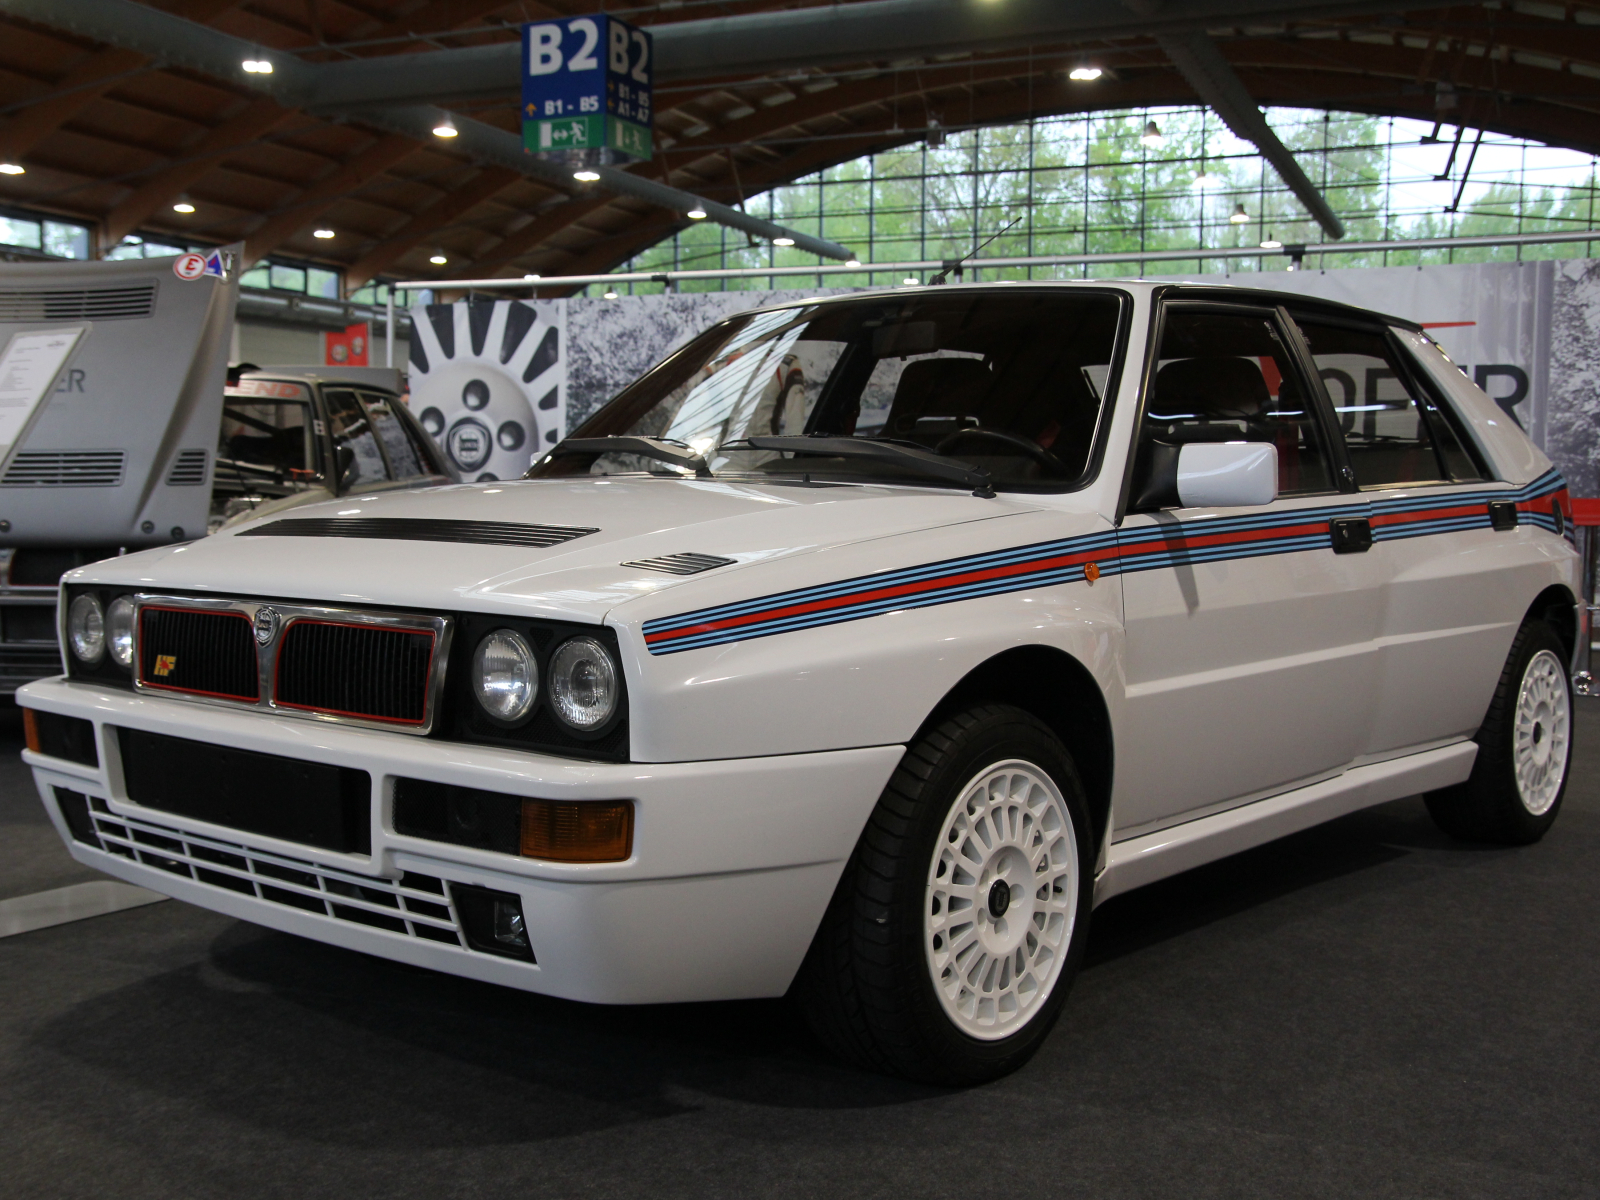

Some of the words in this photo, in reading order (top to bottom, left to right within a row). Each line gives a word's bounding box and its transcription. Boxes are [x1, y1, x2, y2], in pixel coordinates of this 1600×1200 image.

[529, 18, 598, 76] B2
[609, 20, 649, 85] B2
[618, 82, 630, 100] B1
[544, 99, 563, 116] B1
[579, 95, 599, 112] B5
[617, 100, 630, 117] A1
[185, 258, 199, 271] E
